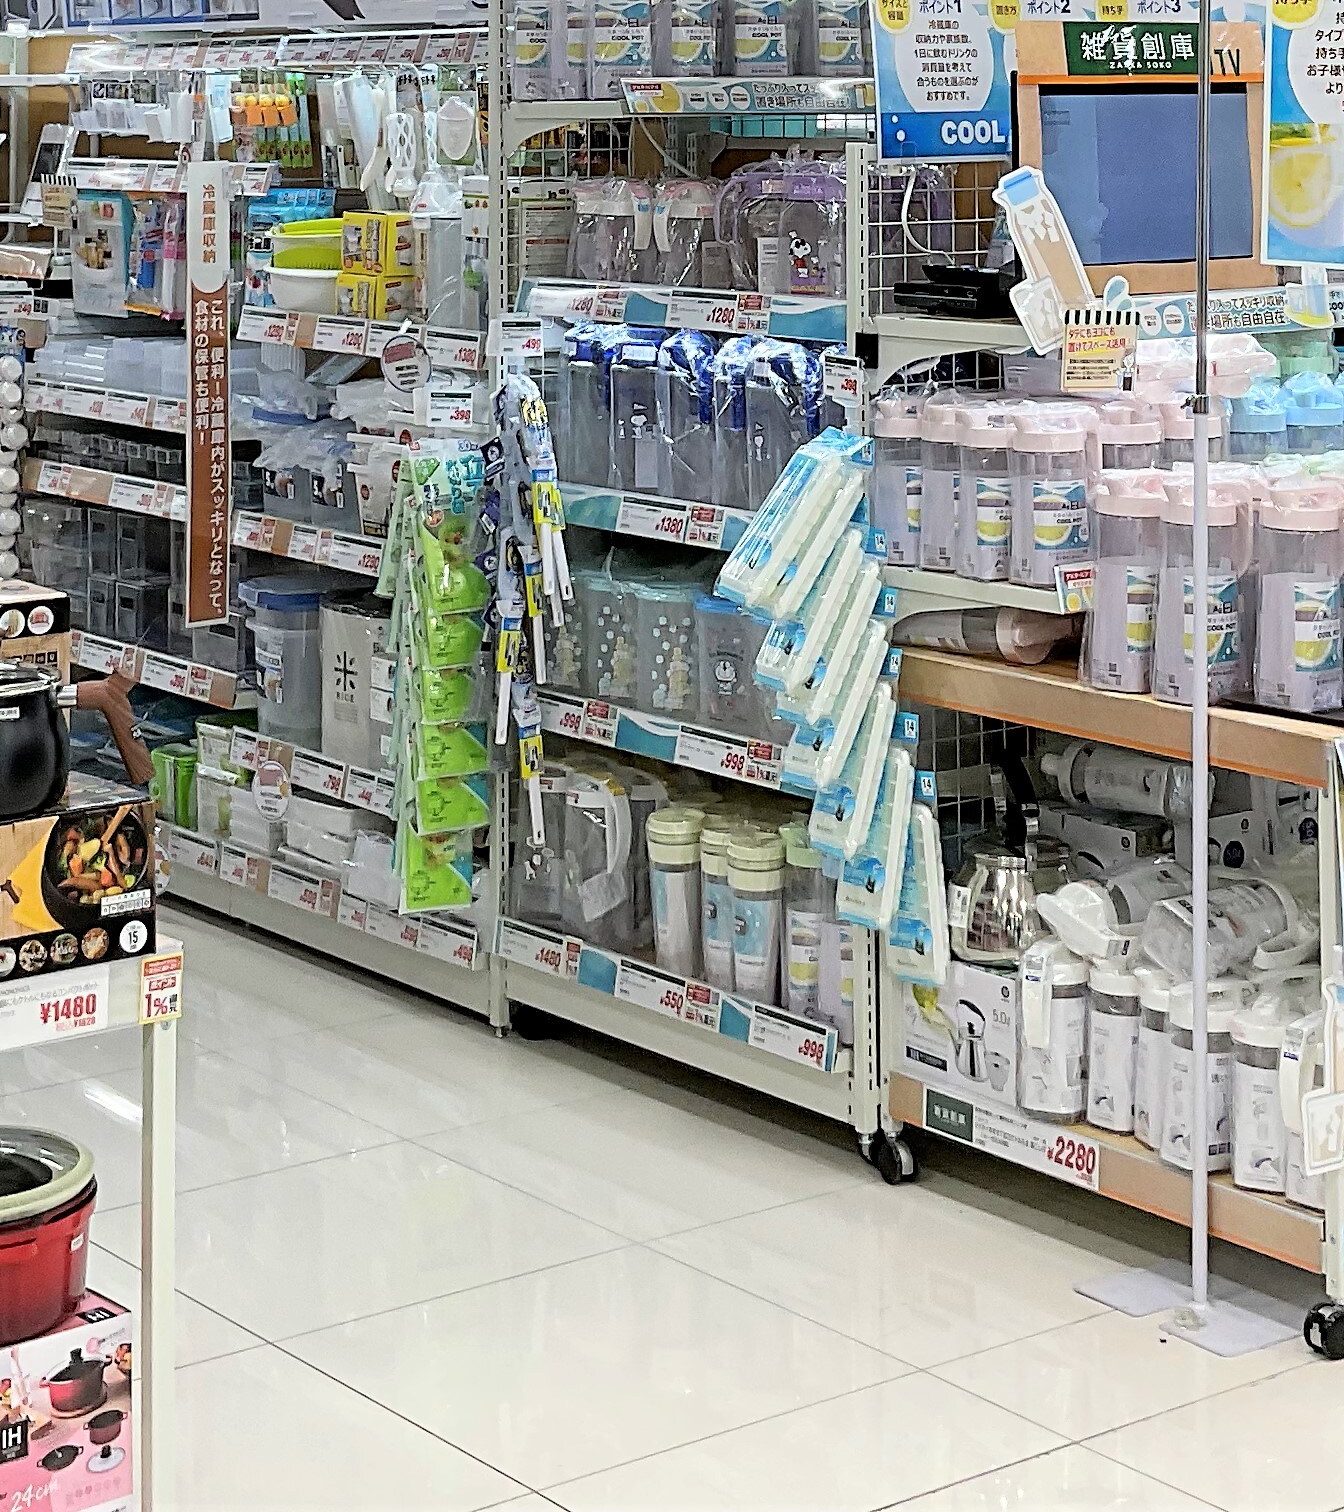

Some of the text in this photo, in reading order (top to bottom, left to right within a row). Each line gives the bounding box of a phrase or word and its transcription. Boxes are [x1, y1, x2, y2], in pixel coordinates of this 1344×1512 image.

[1080, 32, 1195, 61] 雑貨創庫
[941, 120, 1006, 145] COOL
[40, 993, 98, 1026] ¥1480
[2, 1426, 22, 1449] IH
